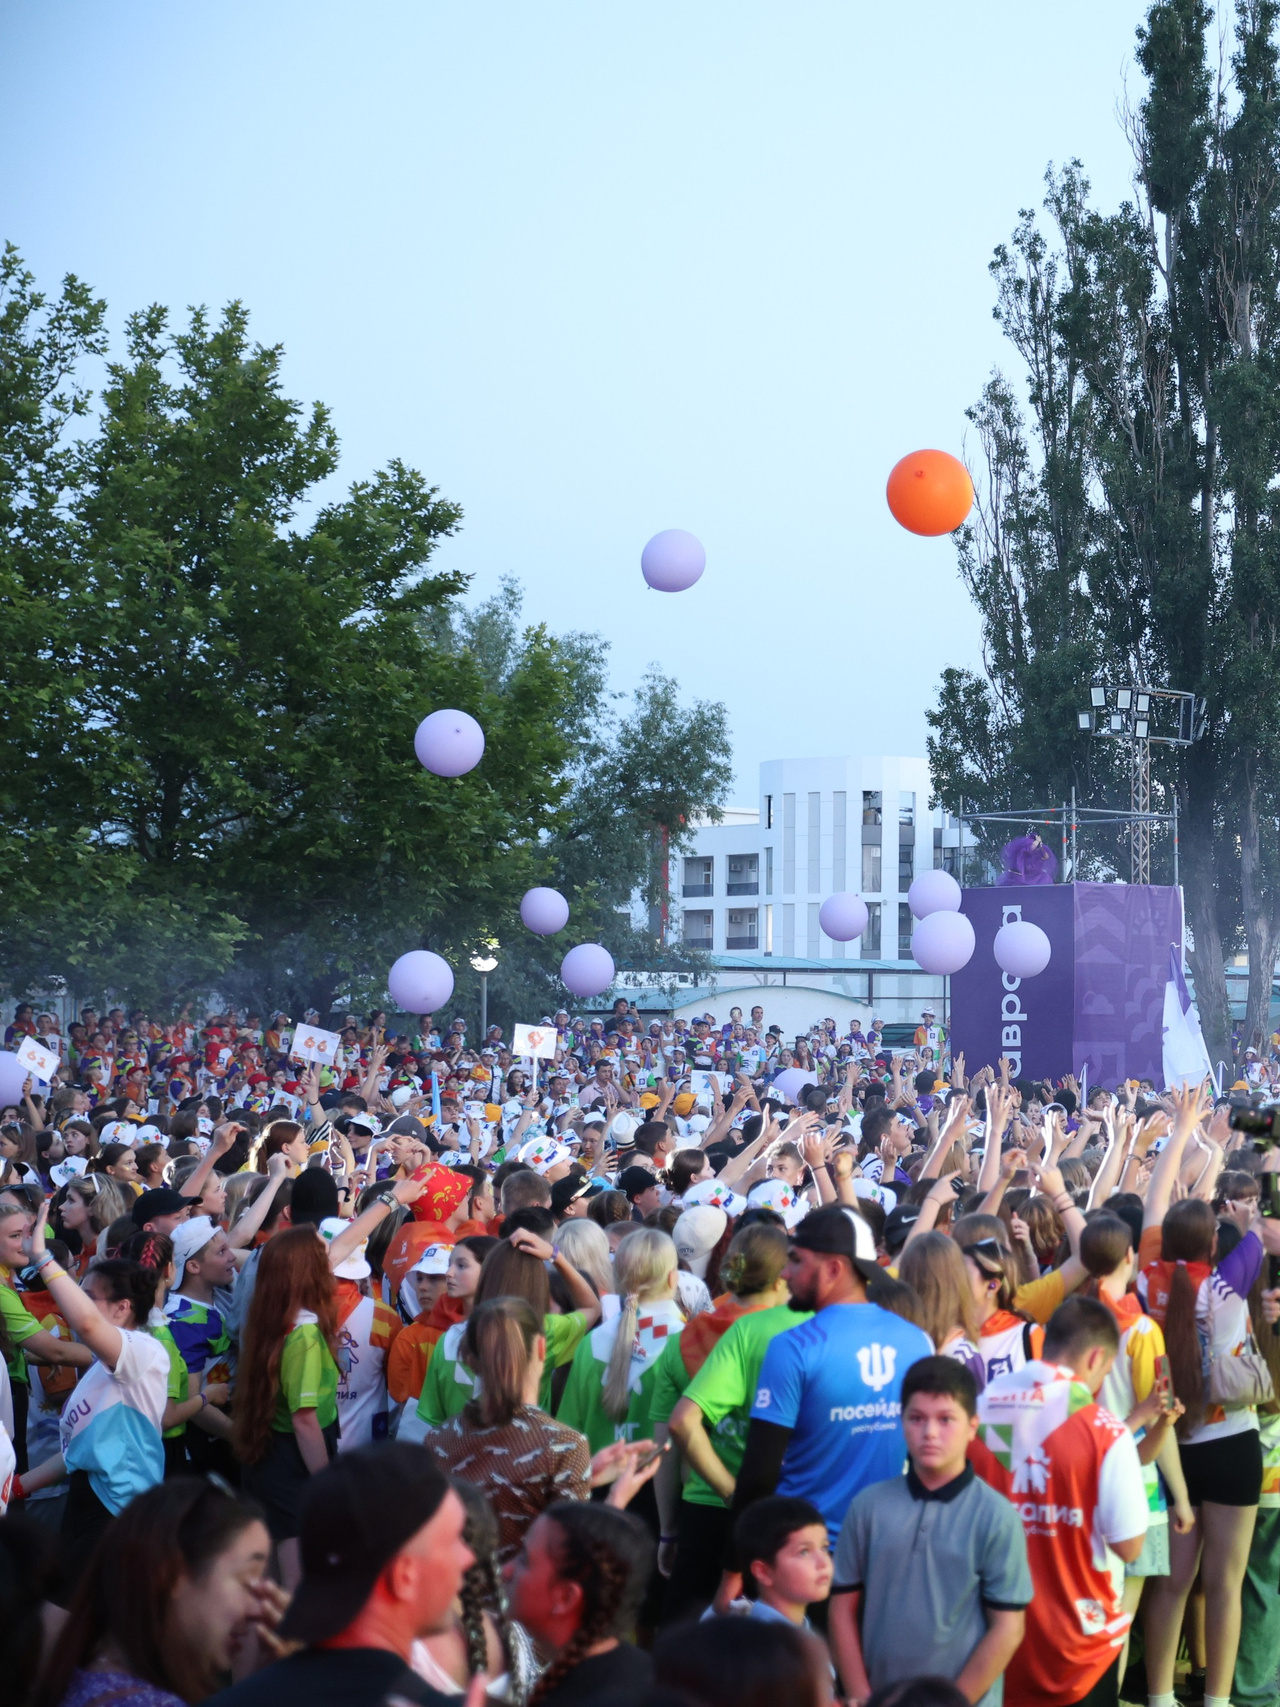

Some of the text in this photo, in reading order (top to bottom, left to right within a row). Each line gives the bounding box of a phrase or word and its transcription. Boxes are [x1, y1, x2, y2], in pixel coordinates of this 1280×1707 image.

[1001, 905, 1028, 1079] авроа
[303, 1036, 328, 1053] 66
[65, 1398, 92, 1430] YOU
